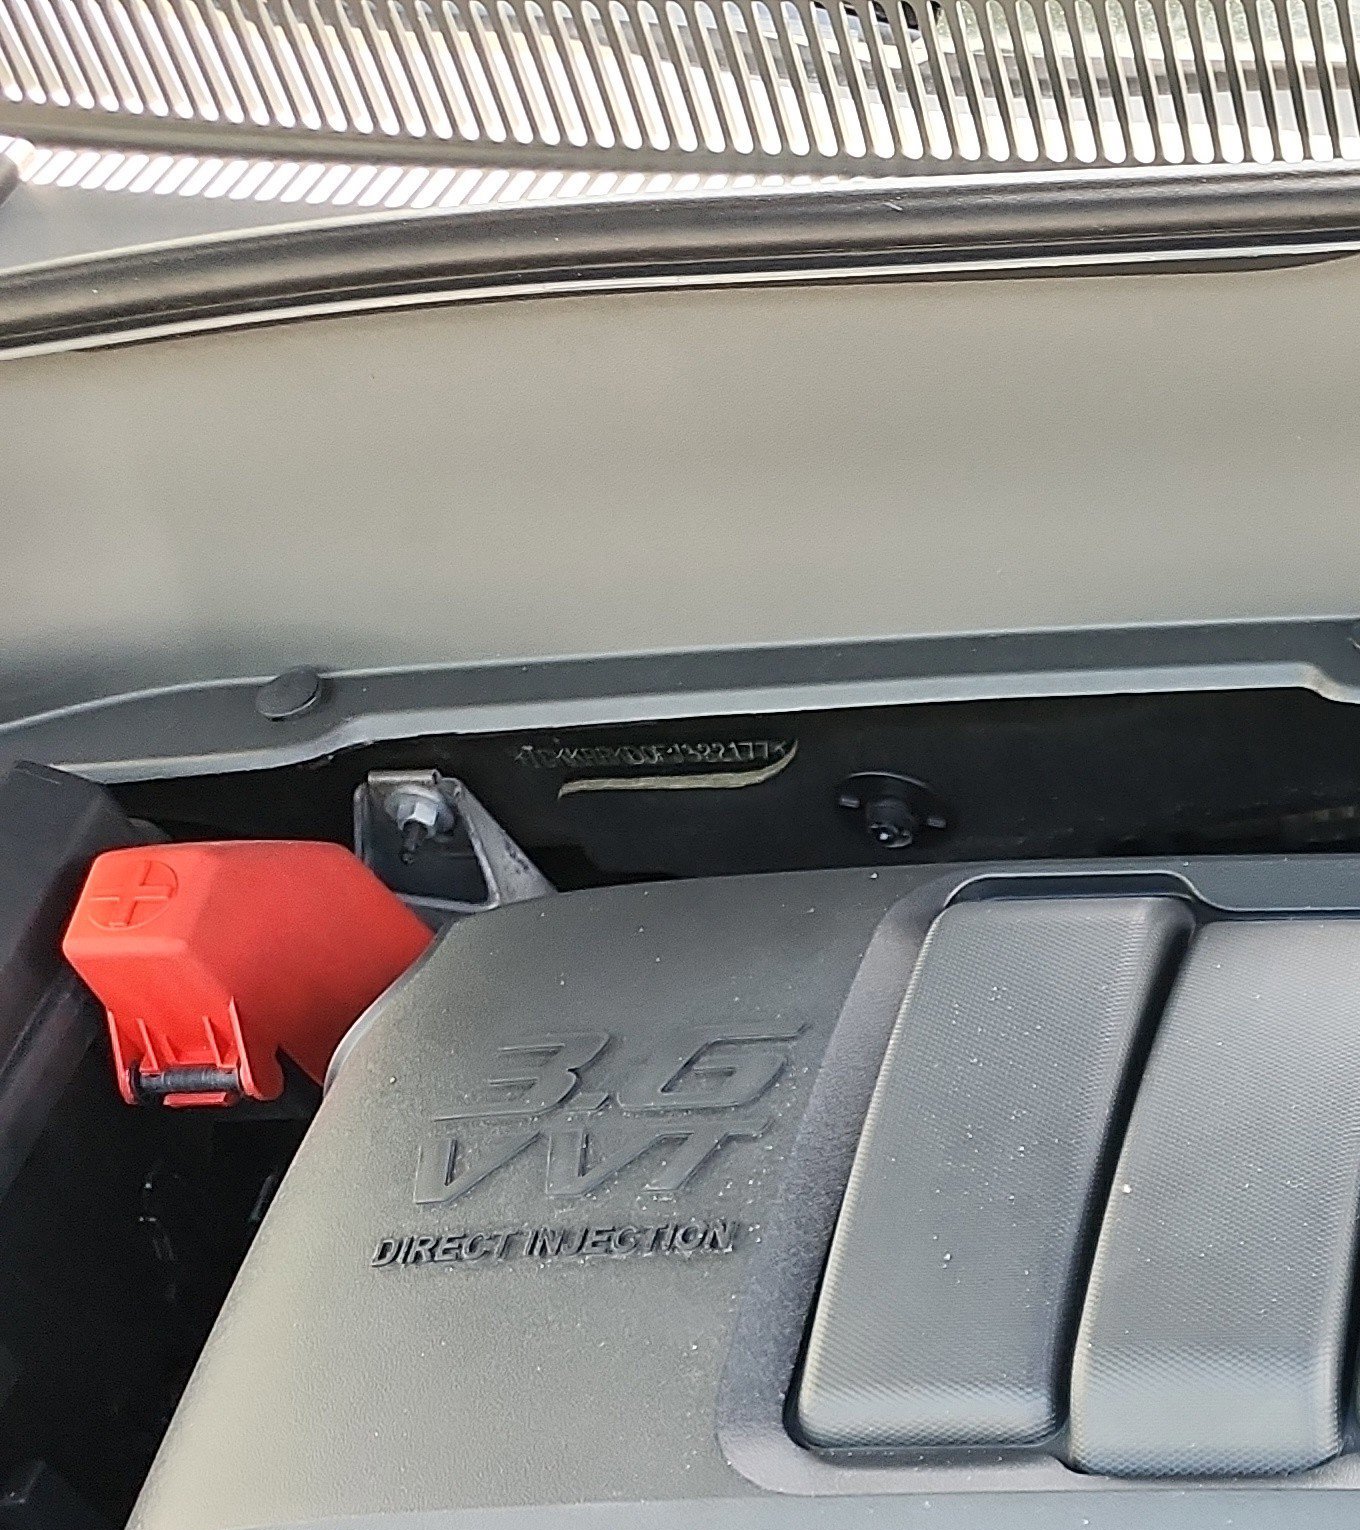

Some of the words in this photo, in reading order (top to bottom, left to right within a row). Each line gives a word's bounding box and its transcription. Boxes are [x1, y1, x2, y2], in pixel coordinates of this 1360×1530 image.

[434, 1025, 811, 1121] 3.6
[414, 1119, 774, 1204] VVT
[371, 1229, 518, 1268] DIRECT
[524, 1219, 740, 1258] INJECTION
